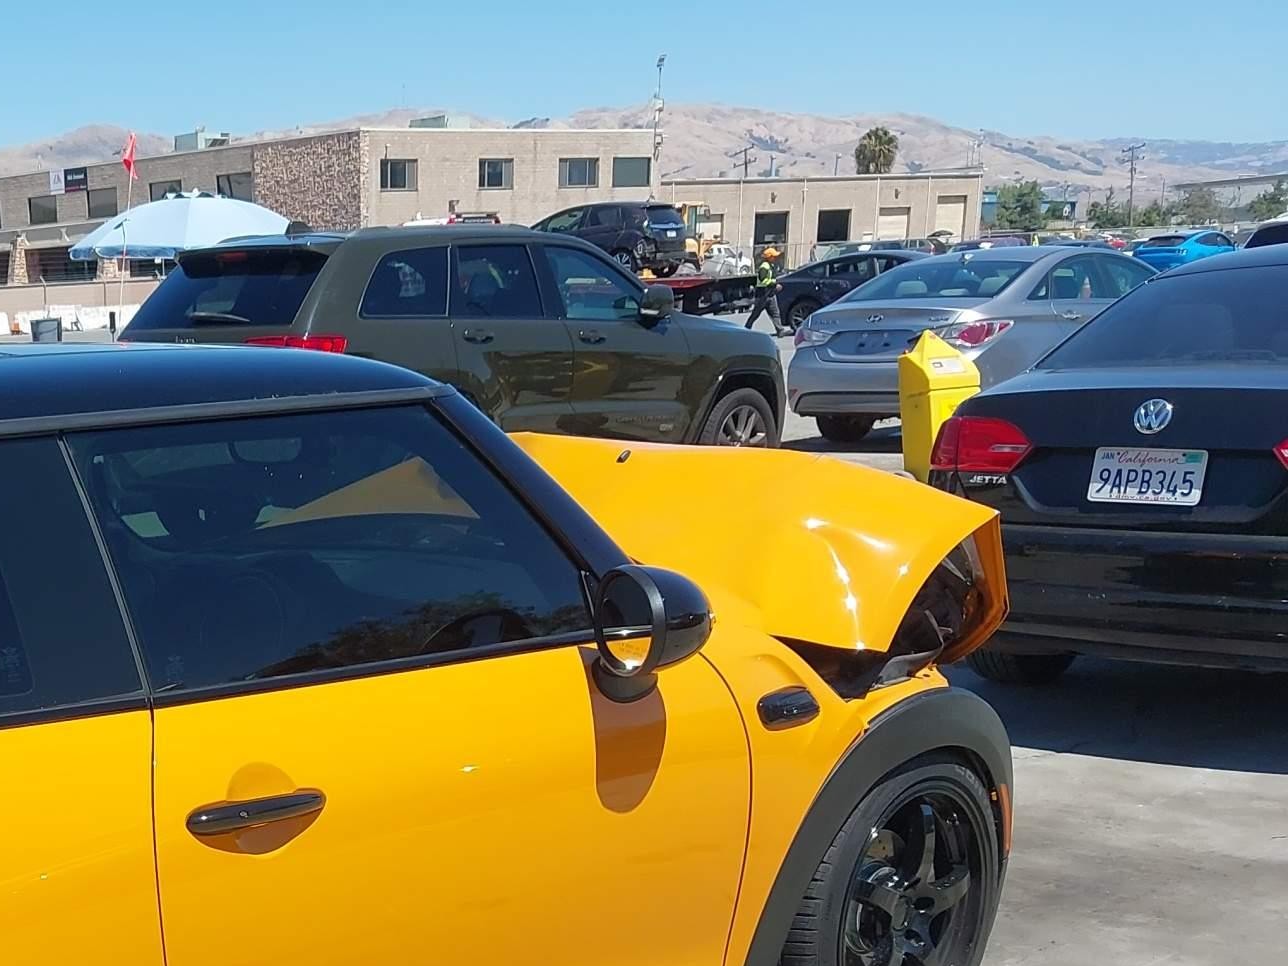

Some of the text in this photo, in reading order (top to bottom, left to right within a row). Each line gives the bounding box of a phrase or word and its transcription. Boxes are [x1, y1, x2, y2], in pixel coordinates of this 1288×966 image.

[1101, 451, 1179, 467] JAN California
[969, 475, 1007, 484] JETTA
[1095, 468, 1195, 496] 9APB345
